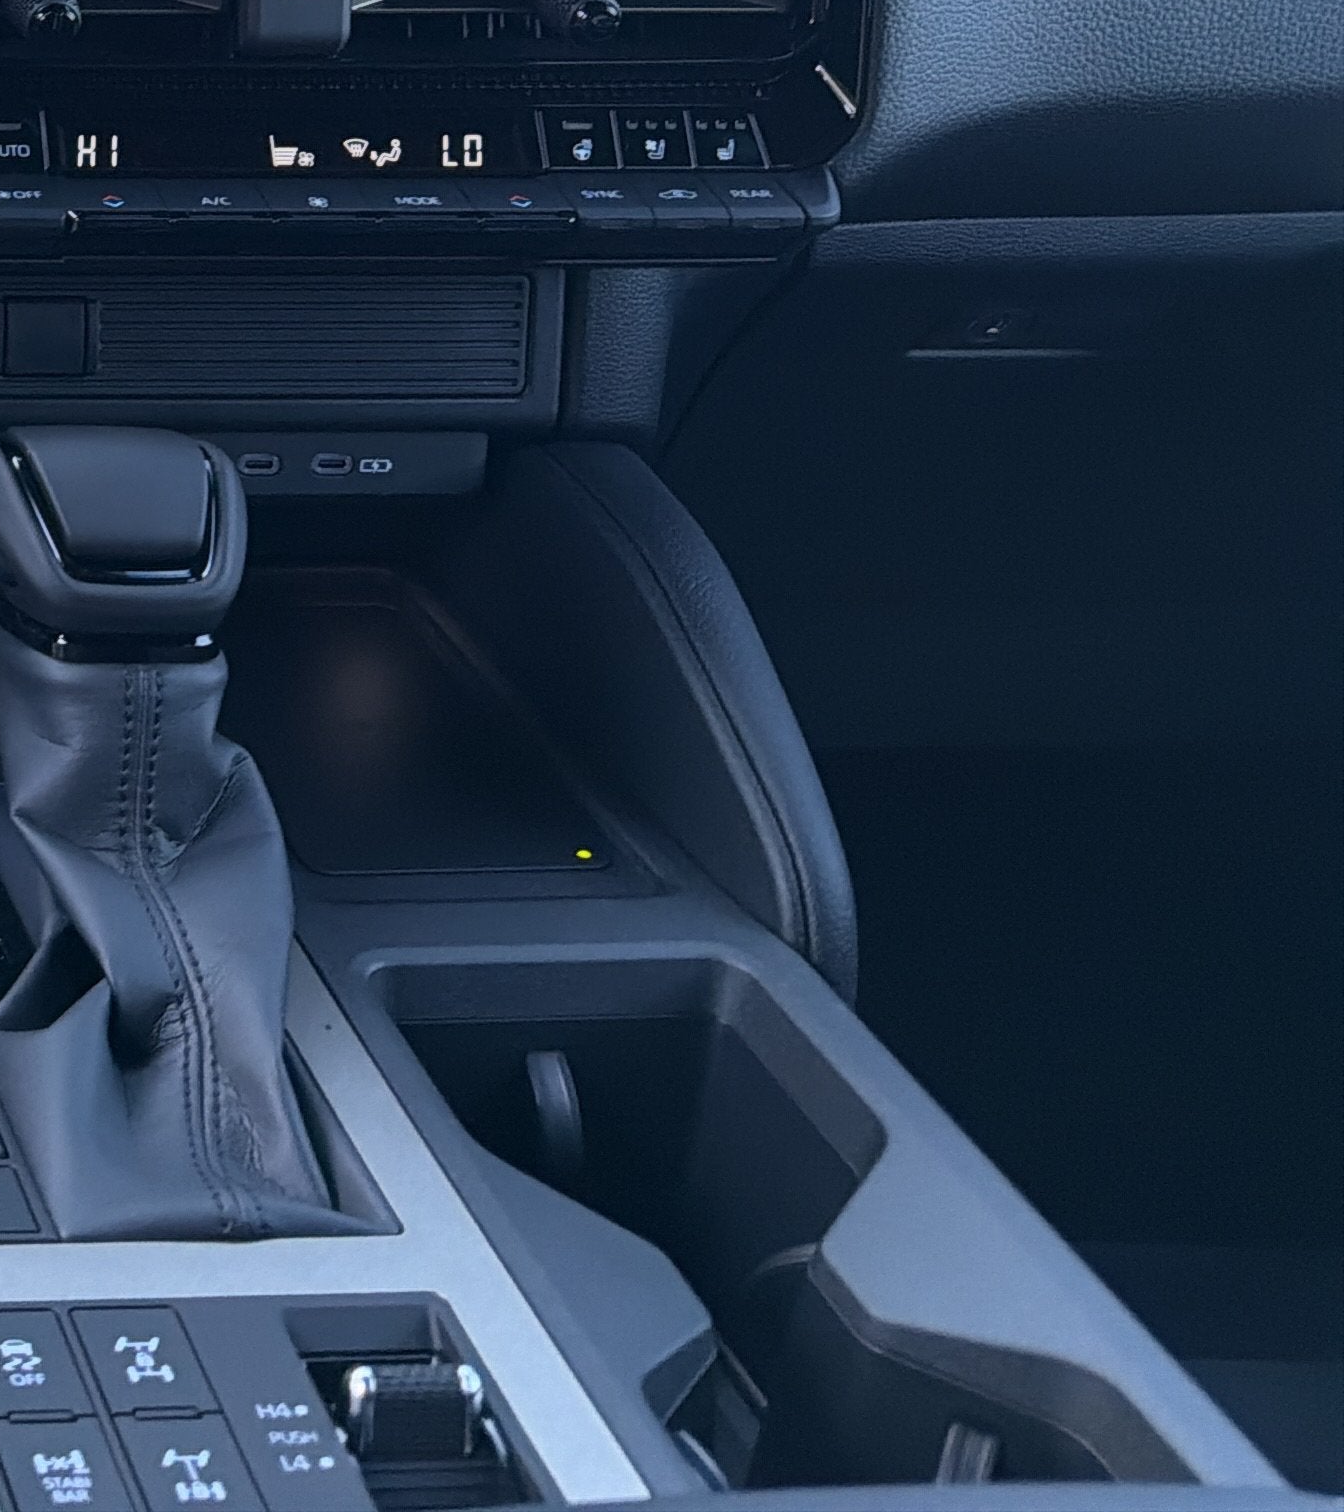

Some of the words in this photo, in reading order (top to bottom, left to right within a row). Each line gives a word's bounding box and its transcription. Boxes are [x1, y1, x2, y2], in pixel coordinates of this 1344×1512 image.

[77, 134, 118, 168] HI
[442, 134, 483, 168] LO
[13, 190, 42, 200] OFF
[201, 196, 232, 206] A/C
[394, 196, 443, 206] MODE
[9, 1373, 46, 1387] OFF
[255, 1402, 293, 1419] H4
[268, 1430, 319, 1445] PUSH
[279, 1454, 311, 1471] L4
